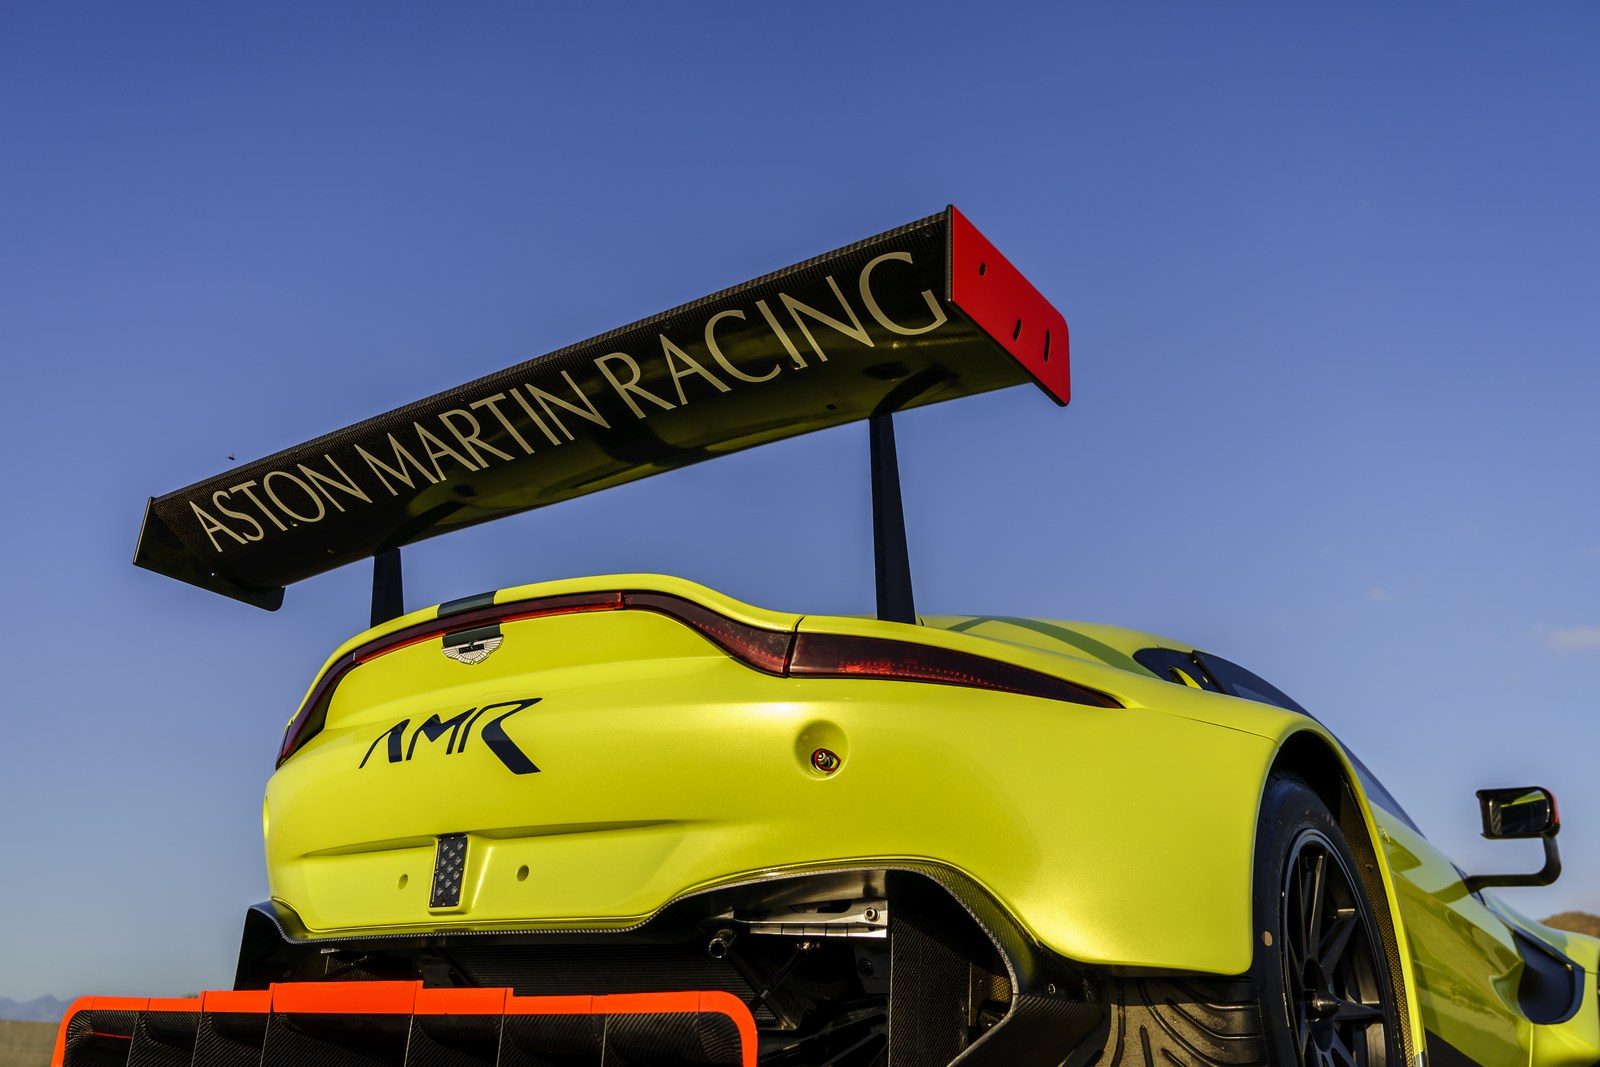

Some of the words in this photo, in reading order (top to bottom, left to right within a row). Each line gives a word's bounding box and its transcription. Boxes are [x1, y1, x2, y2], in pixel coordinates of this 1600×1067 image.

[189, 454, 373, 553] ASTON
[353, 370, 611, 497] MARTIN
[593, 251, 948, 421] RACING
[358, 697, 543, 775] AMR
